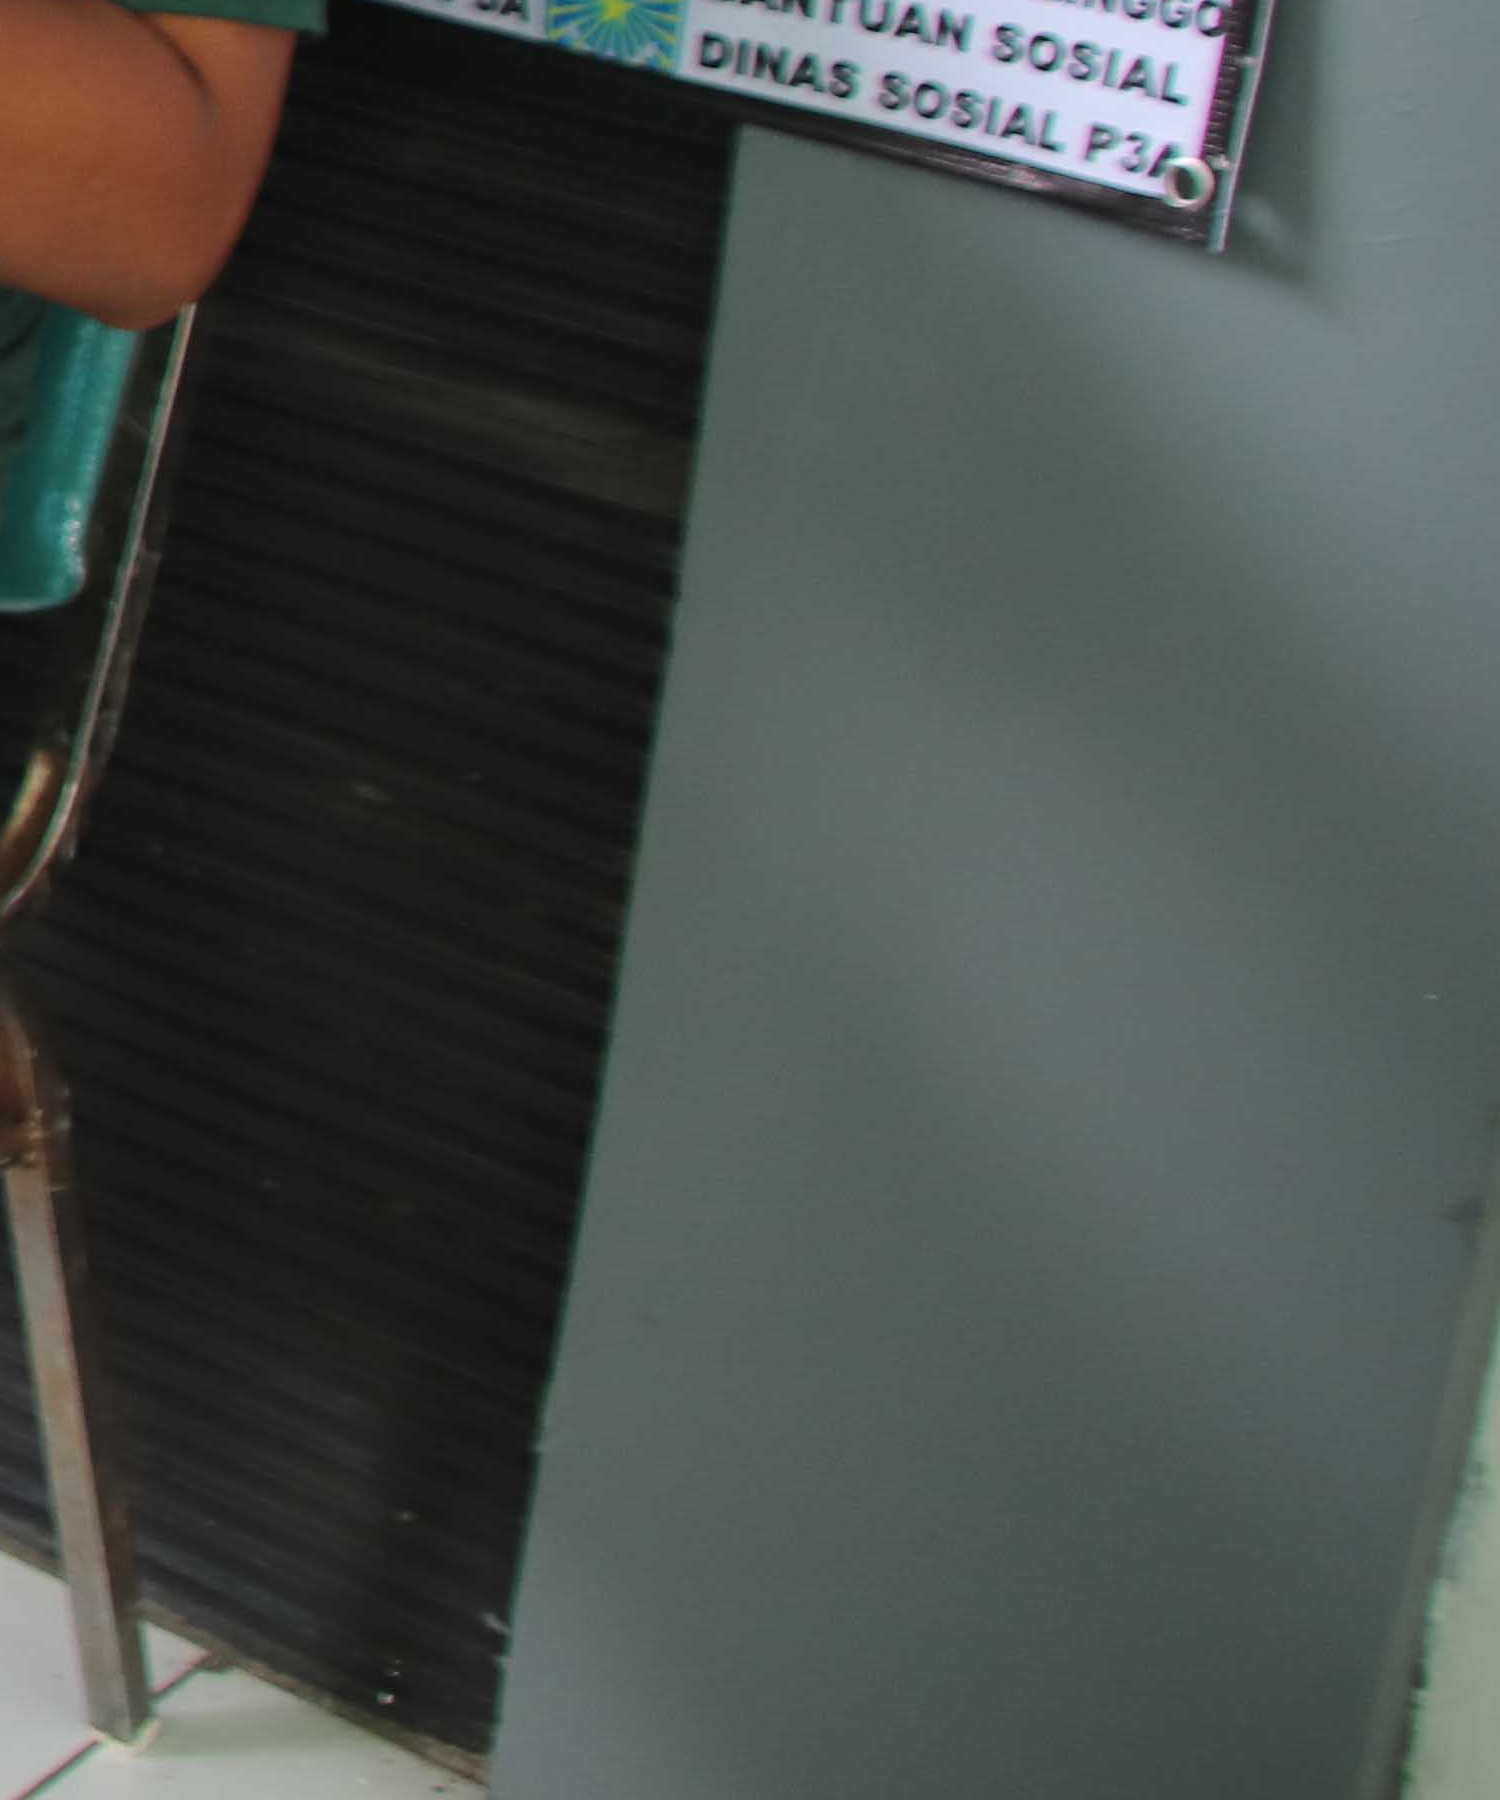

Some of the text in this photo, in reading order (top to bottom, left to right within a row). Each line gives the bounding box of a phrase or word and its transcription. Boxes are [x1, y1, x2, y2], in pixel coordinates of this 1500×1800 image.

[698, 29, 856, 103] DINAS
[877, 68, 1060, 155] SOSIAL
[991, 21, 1185, 108] SOSIAL
